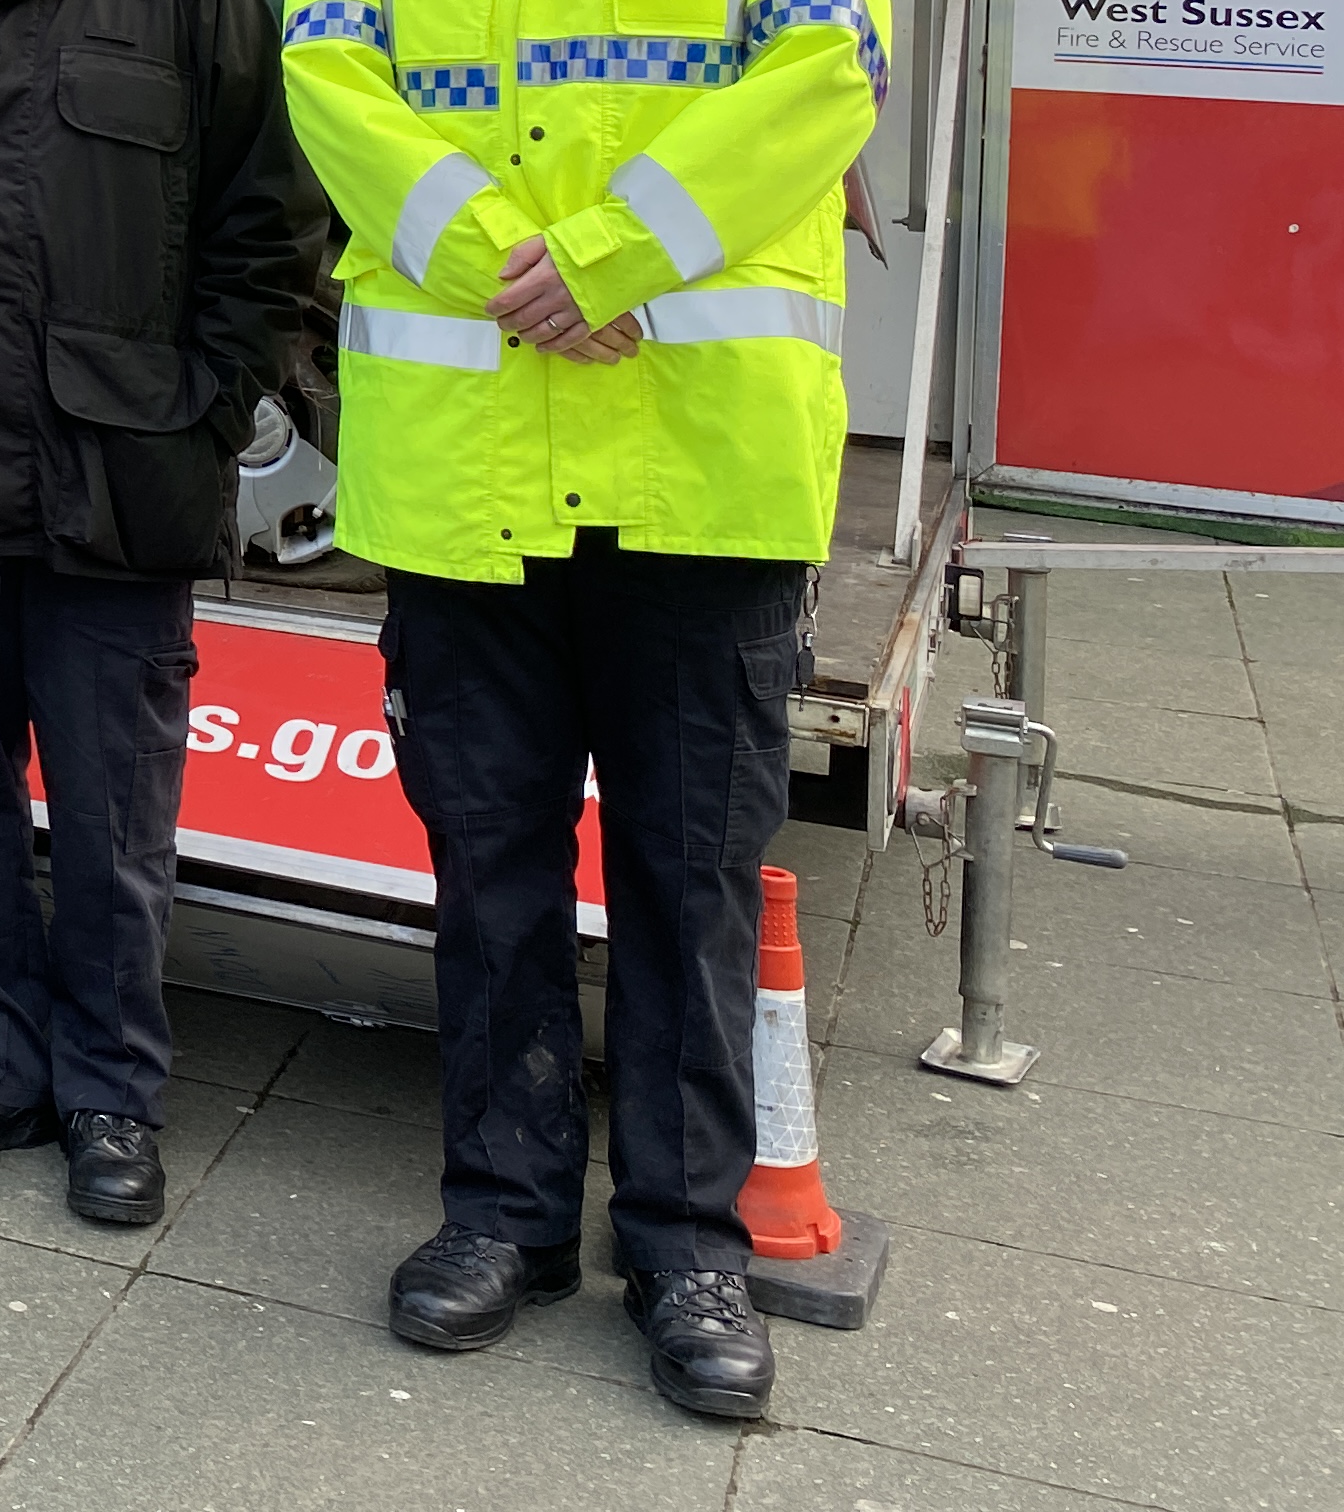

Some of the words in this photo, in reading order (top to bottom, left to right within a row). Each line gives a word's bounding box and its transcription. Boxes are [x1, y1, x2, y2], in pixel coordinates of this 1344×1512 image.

[1056, 27, 1100, 49] Fire
[1108, 30, 1127, 49] &
[1137, 31, 1224, 54] Rescue
[1233, 35, 1326, 59] Service
